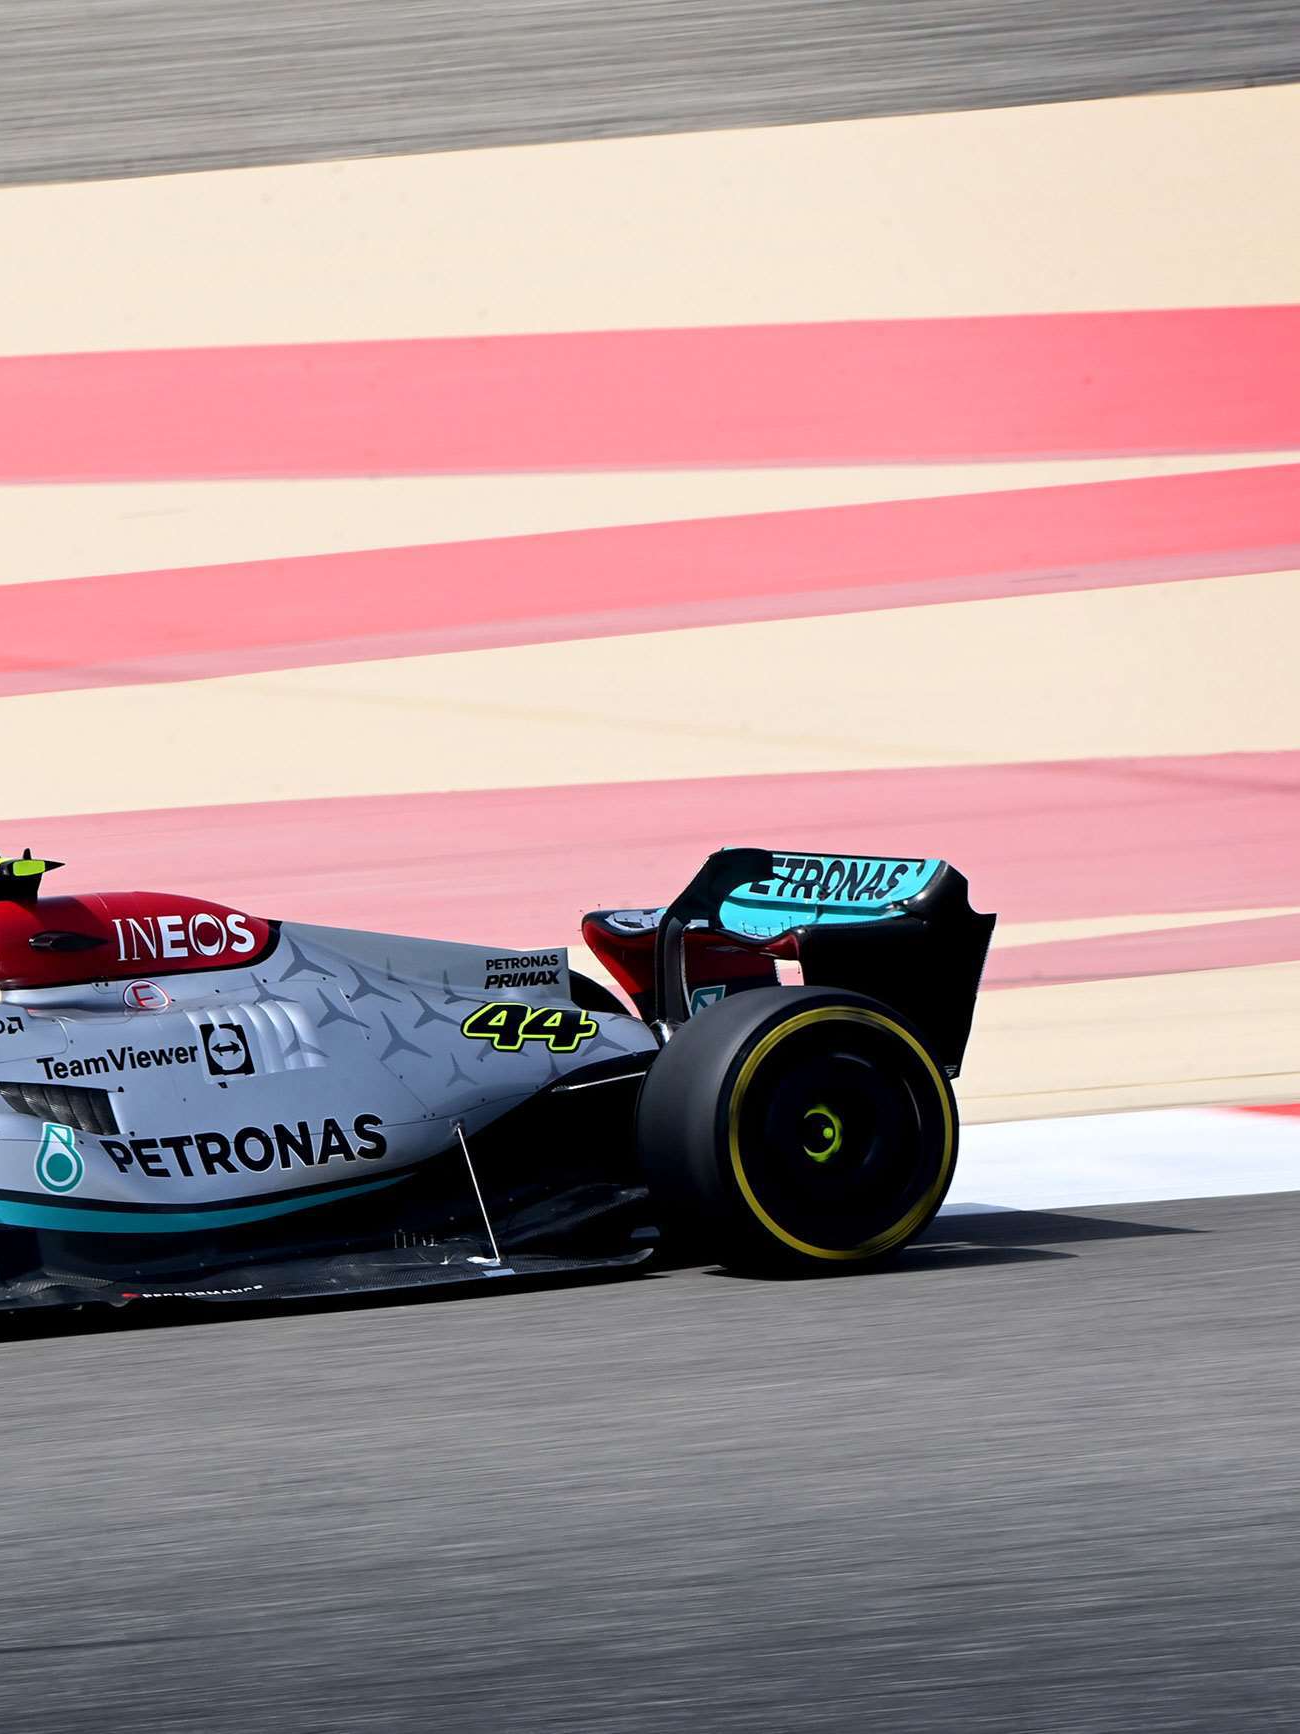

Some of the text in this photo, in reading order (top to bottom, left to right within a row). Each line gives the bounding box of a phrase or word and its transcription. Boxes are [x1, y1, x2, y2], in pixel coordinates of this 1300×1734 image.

[749, 857, 909, 901] ETRONAS
[112, 913, 256, 962] INEOS
[484, 970, 560, 990] PRIMAX
[485, 954, 559, 971] PETRONAS
[462, 1001, 599, 1054] 44
[36, 1044, 200, 1081] TeamViewer
[99, 1113, 389, 1178] PETRONAS
